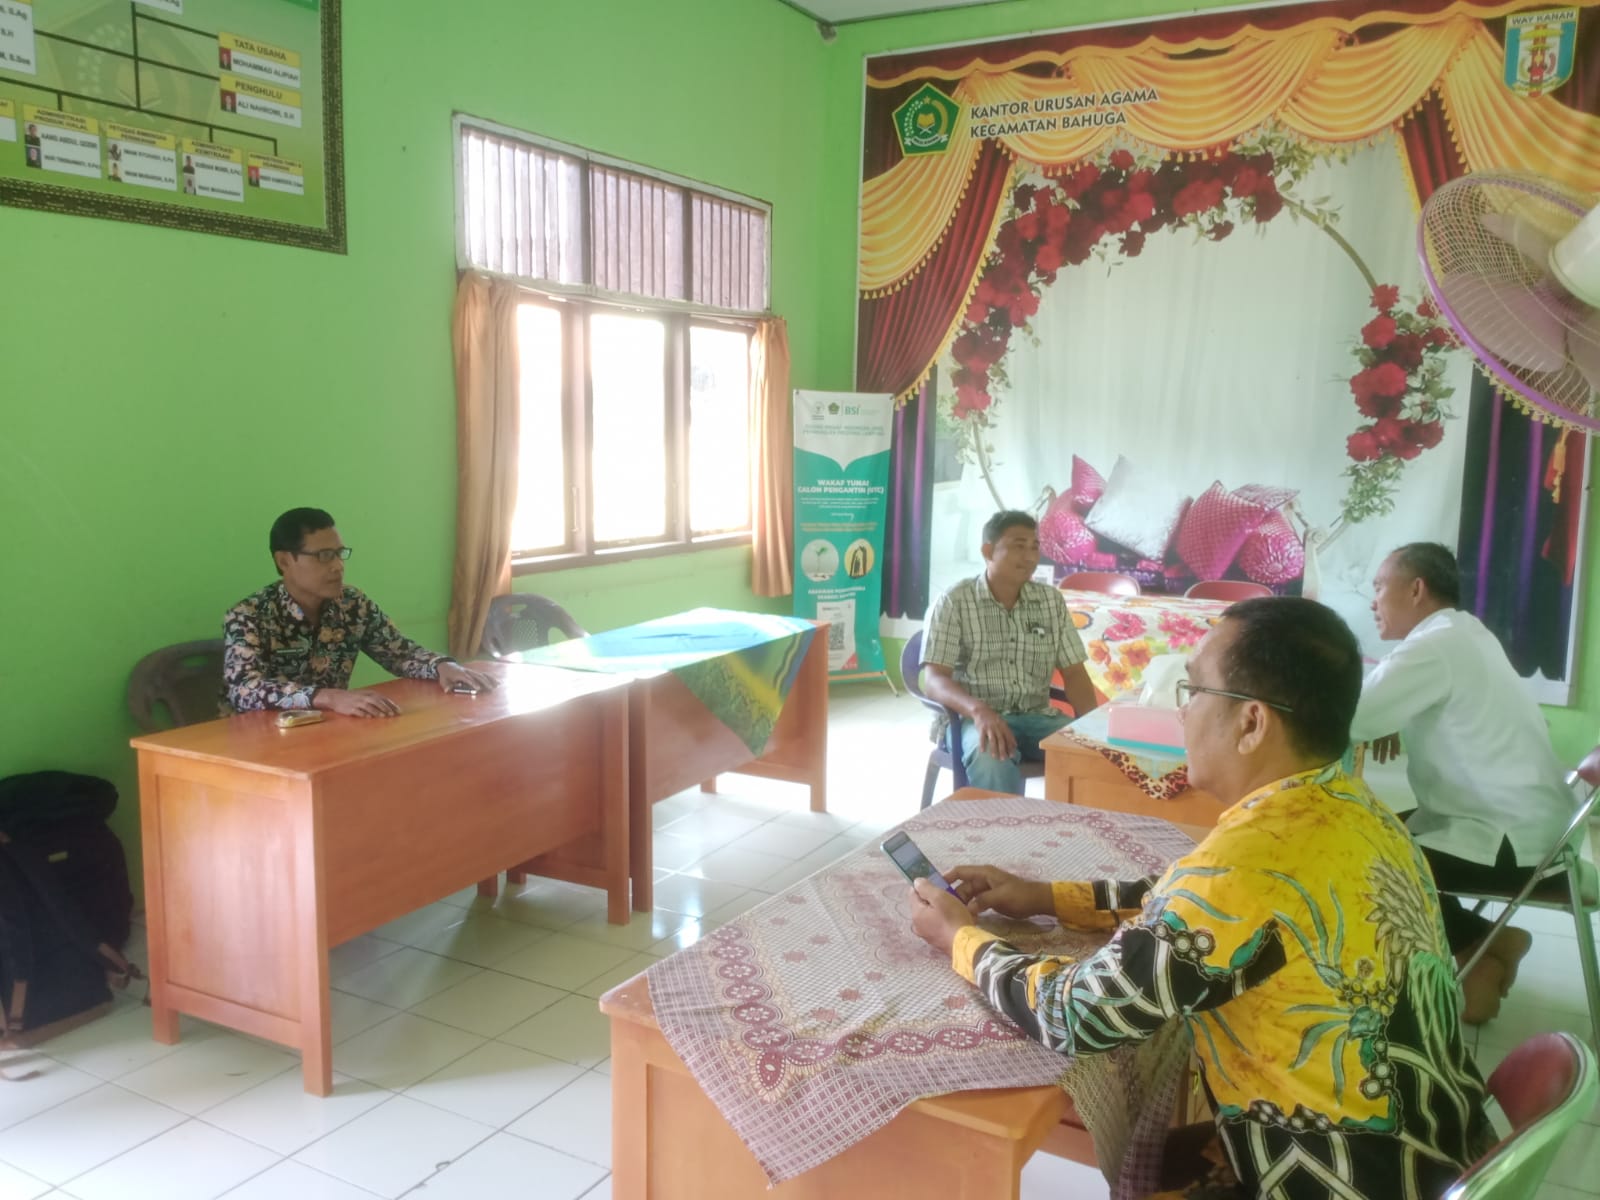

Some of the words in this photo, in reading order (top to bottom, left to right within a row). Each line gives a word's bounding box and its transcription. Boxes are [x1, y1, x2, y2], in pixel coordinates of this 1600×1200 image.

[1512, 15, 1534, 25] WAY
[1537, 11, 1574, 22] KANAN
[233, 38, 255, 52] TATA
[257, 46, 287, 61] USAHA
[235, 80, 283, 100] PENGHULU
[971, 101, 1029, 120] KANTOR
[1034, 94, 1095, 112] URUSAN
[1100, 88, 1157, 106] AGAMA
[970, 118, 1057, 138] KECAMATAN
[1062, 111, 1126, 129] BAHUGA
[798, 486, 822, 494] CALON
[823, 486, 866, 494] PENGANTIN
[817, 479, 845, 487] WAKAF
[846, 479, 870, 487] TUNAI
